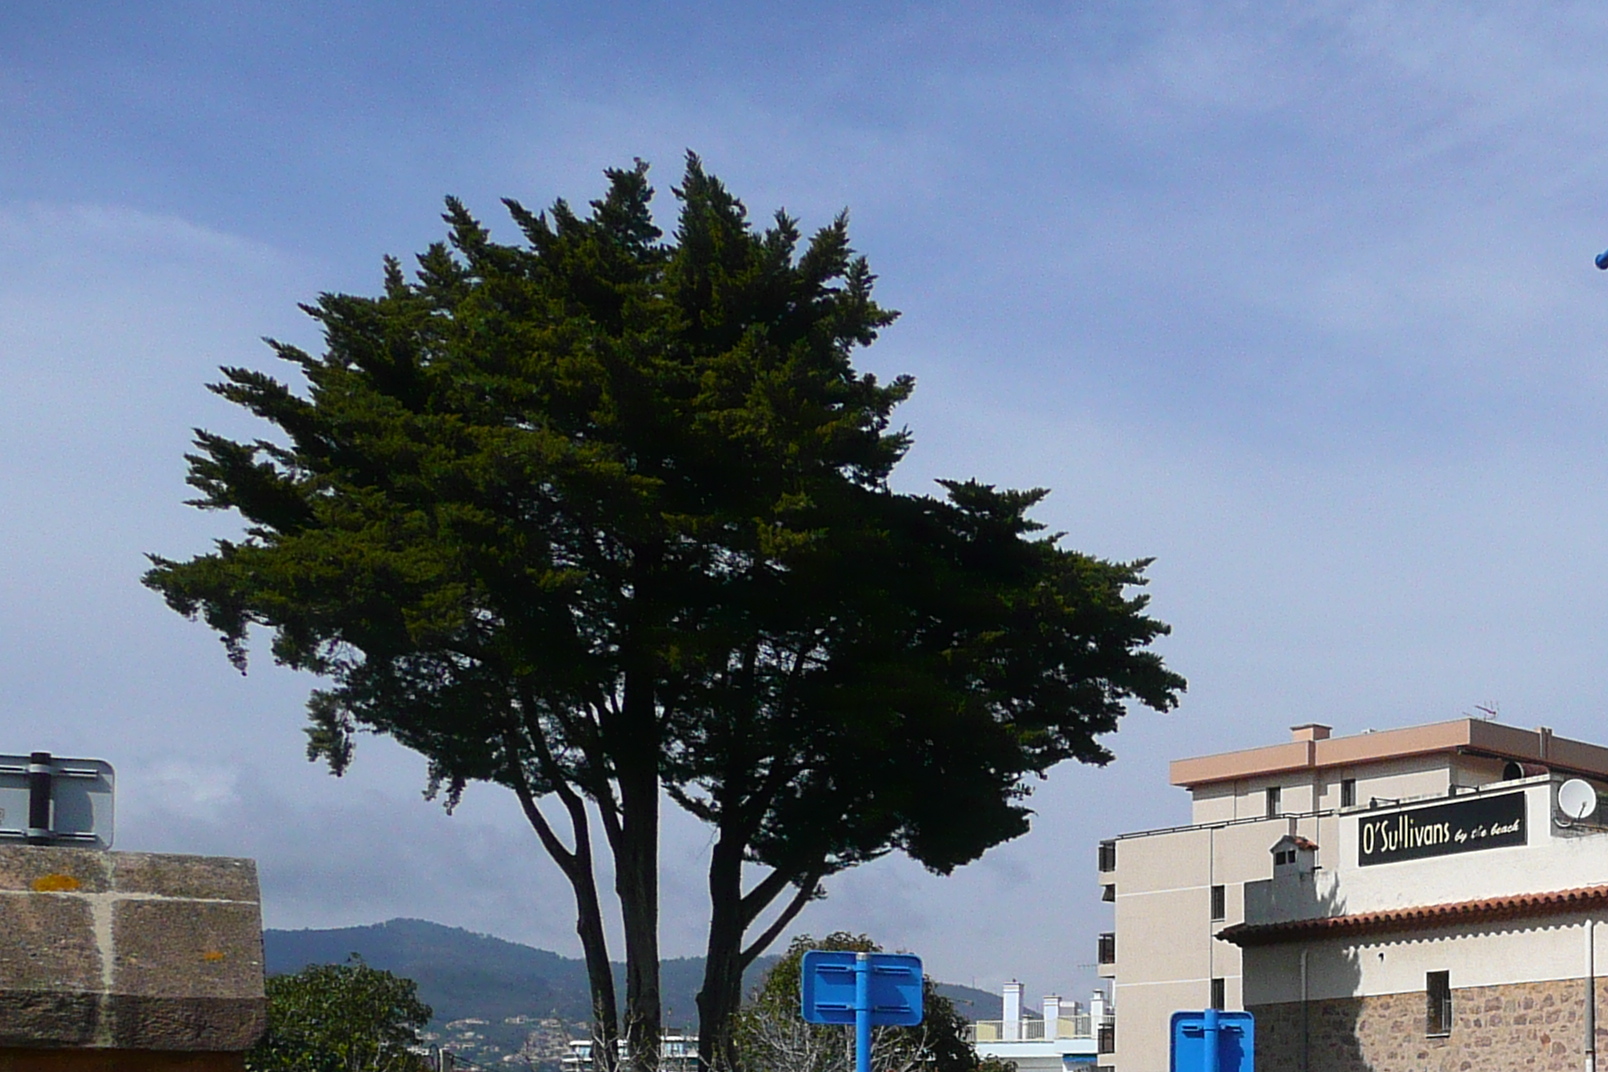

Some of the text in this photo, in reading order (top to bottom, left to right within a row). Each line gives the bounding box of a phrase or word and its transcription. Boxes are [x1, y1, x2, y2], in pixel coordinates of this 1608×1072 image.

[1363, 814, 1450, 855] O'Sullivans
[1454, 828, 1467, 843] by
[1490, 818, 1520, 837] beach
